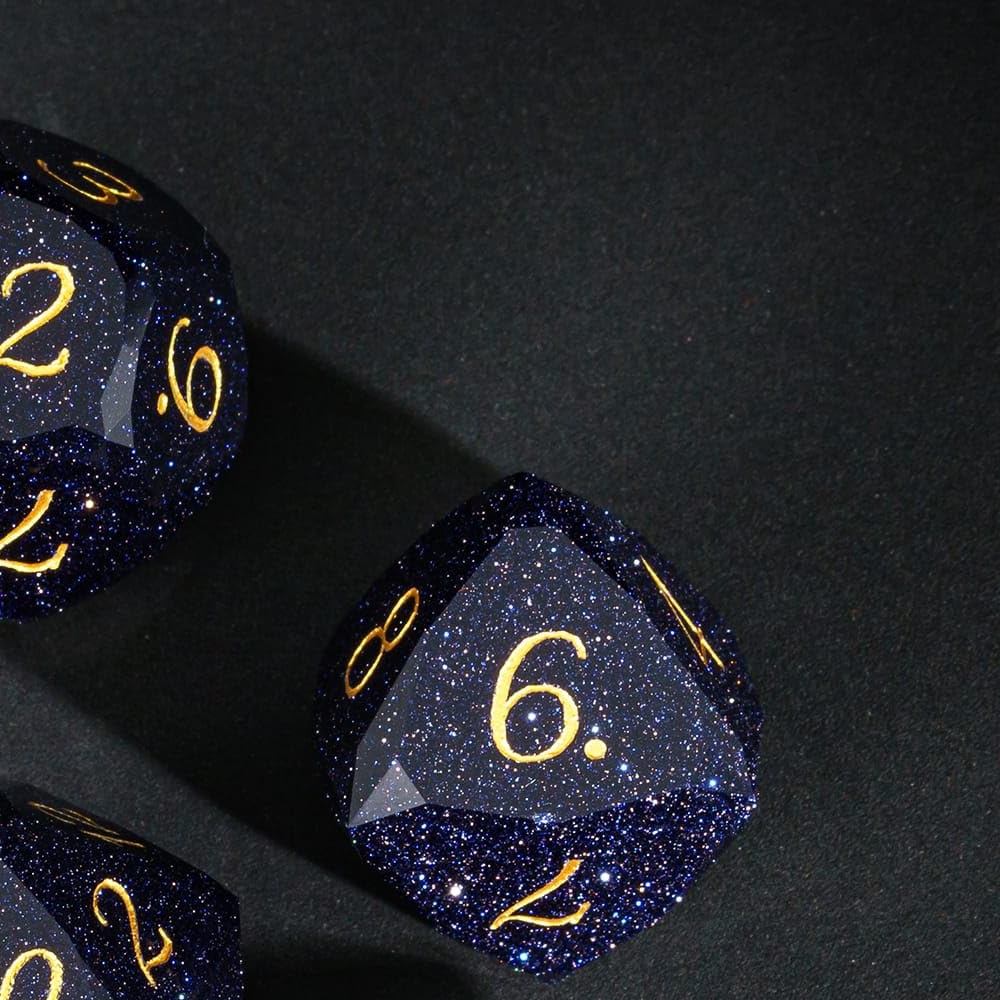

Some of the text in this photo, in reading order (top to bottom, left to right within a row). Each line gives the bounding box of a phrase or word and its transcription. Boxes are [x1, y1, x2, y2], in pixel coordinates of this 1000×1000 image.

[36, 160, 143, 206] 3
[345, 587, 420, 698] 8
[92, 876, 173, 989] 2
